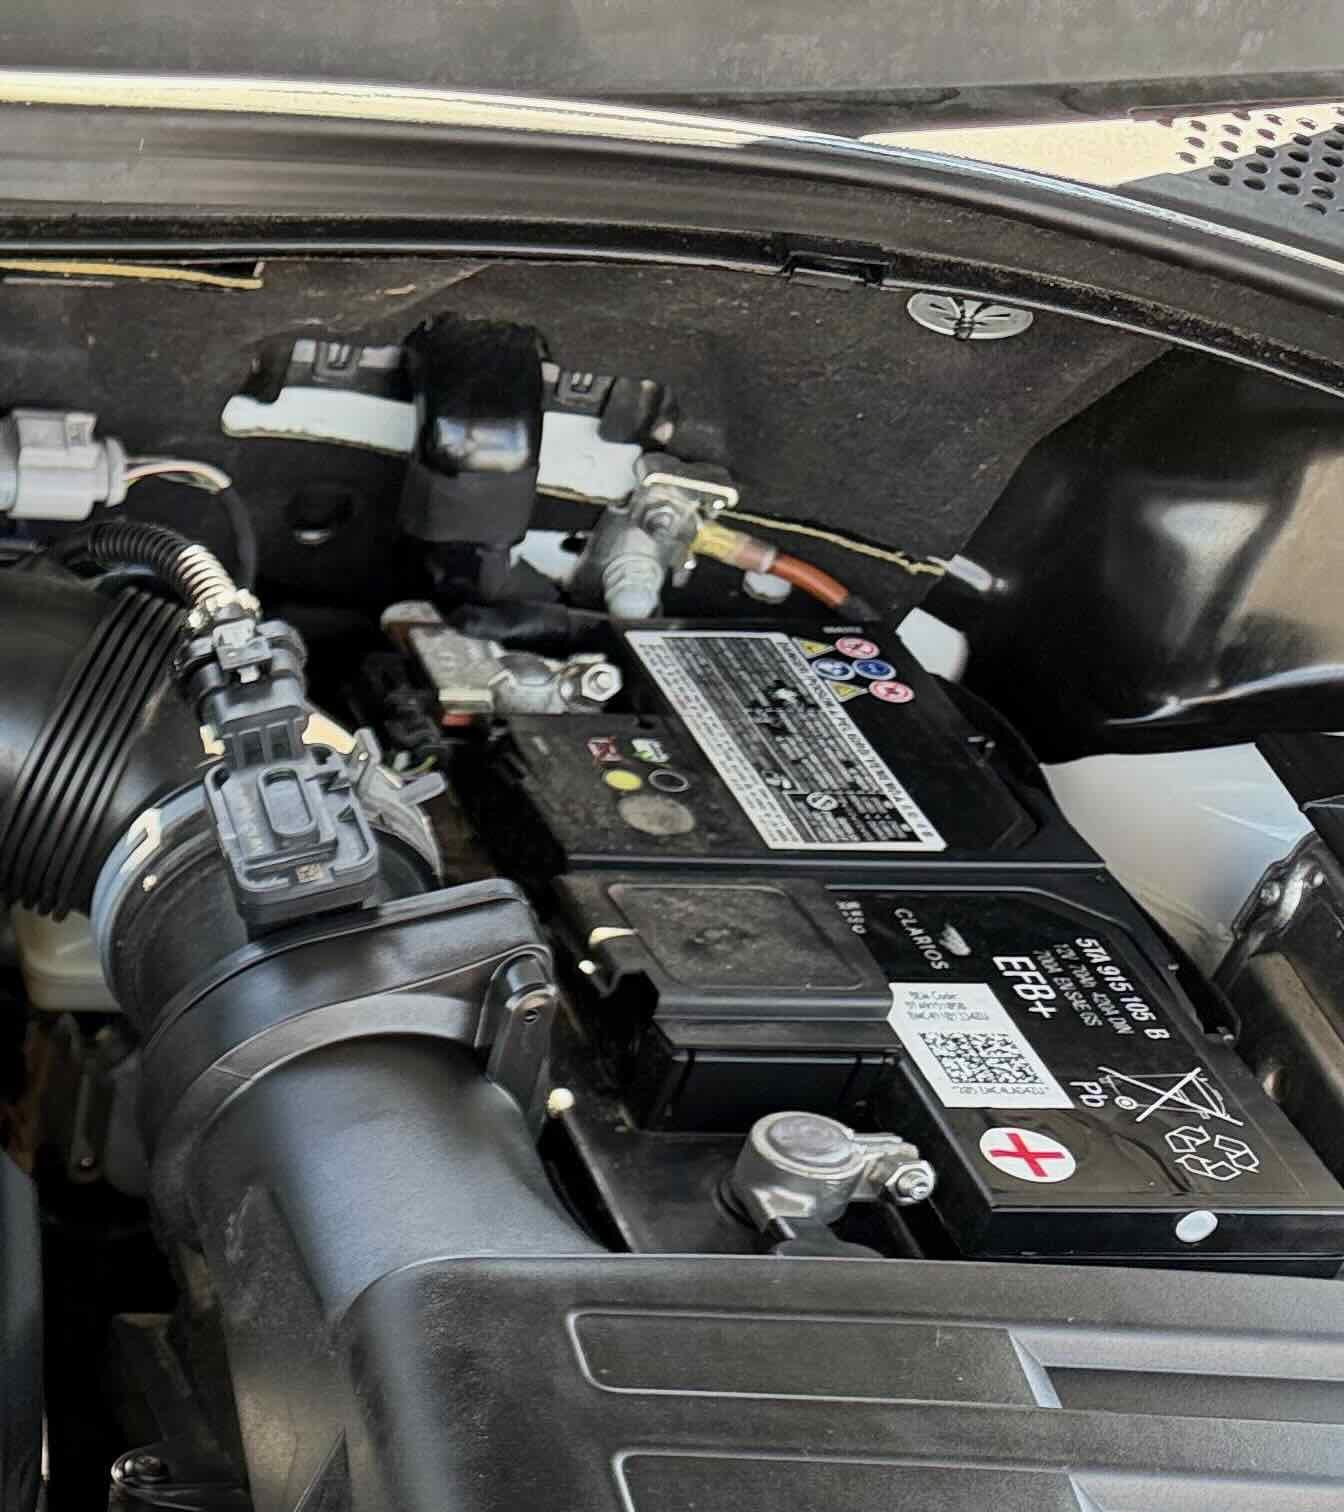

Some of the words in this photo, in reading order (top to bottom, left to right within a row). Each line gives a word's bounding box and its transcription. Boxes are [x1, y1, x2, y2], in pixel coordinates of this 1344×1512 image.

[894, 908, 949, 969] CLARIOS
[993, 956, 1057, 1018] EFB+
[1075, 938, 1111, 963] 5TA
[1096, 965, 1134, 991] 915
[1120, 996, 1156, 1021] 105
[1144, 1028, 1170, 1039] B
[1070, 1080, 1106, 1108] Pb
